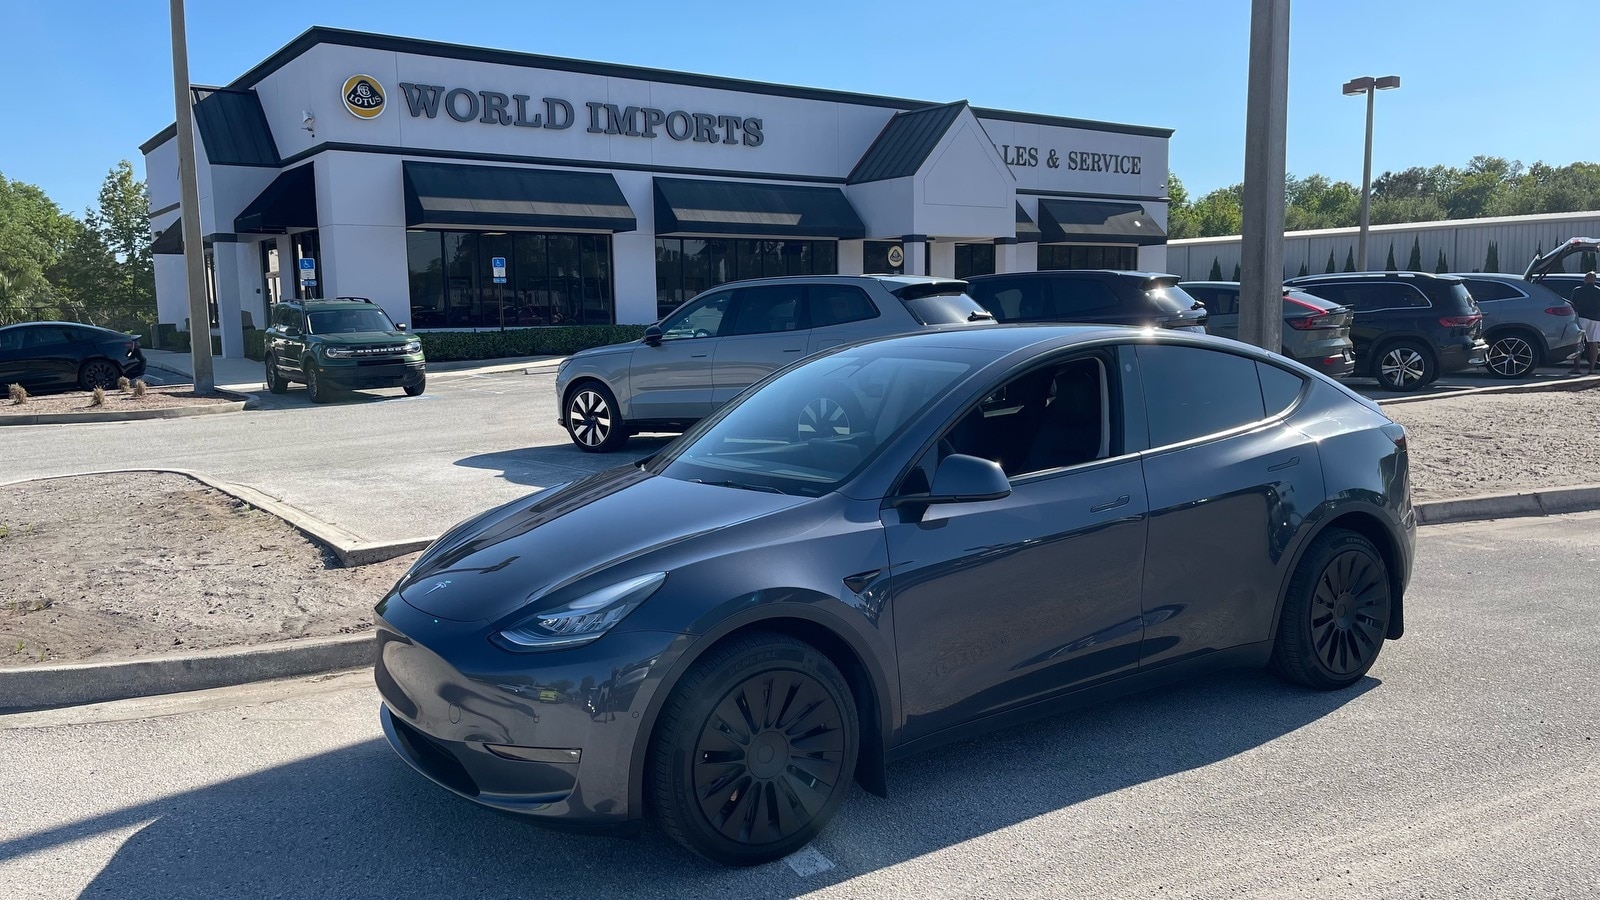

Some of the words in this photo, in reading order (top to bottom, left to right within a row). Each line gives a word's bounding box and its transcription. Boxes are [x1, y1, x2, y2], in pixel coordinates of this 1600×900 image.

[349, 94, 382, 106] LOTUS
[399, 82, 575, 130] WORLD
[586, 101, 764, 147] IMPORTS
[1002, 145, 1038, 167] LES
[1046, 149, 1060, 169] &
[1068, 151, 1141, 175] SERVICE
